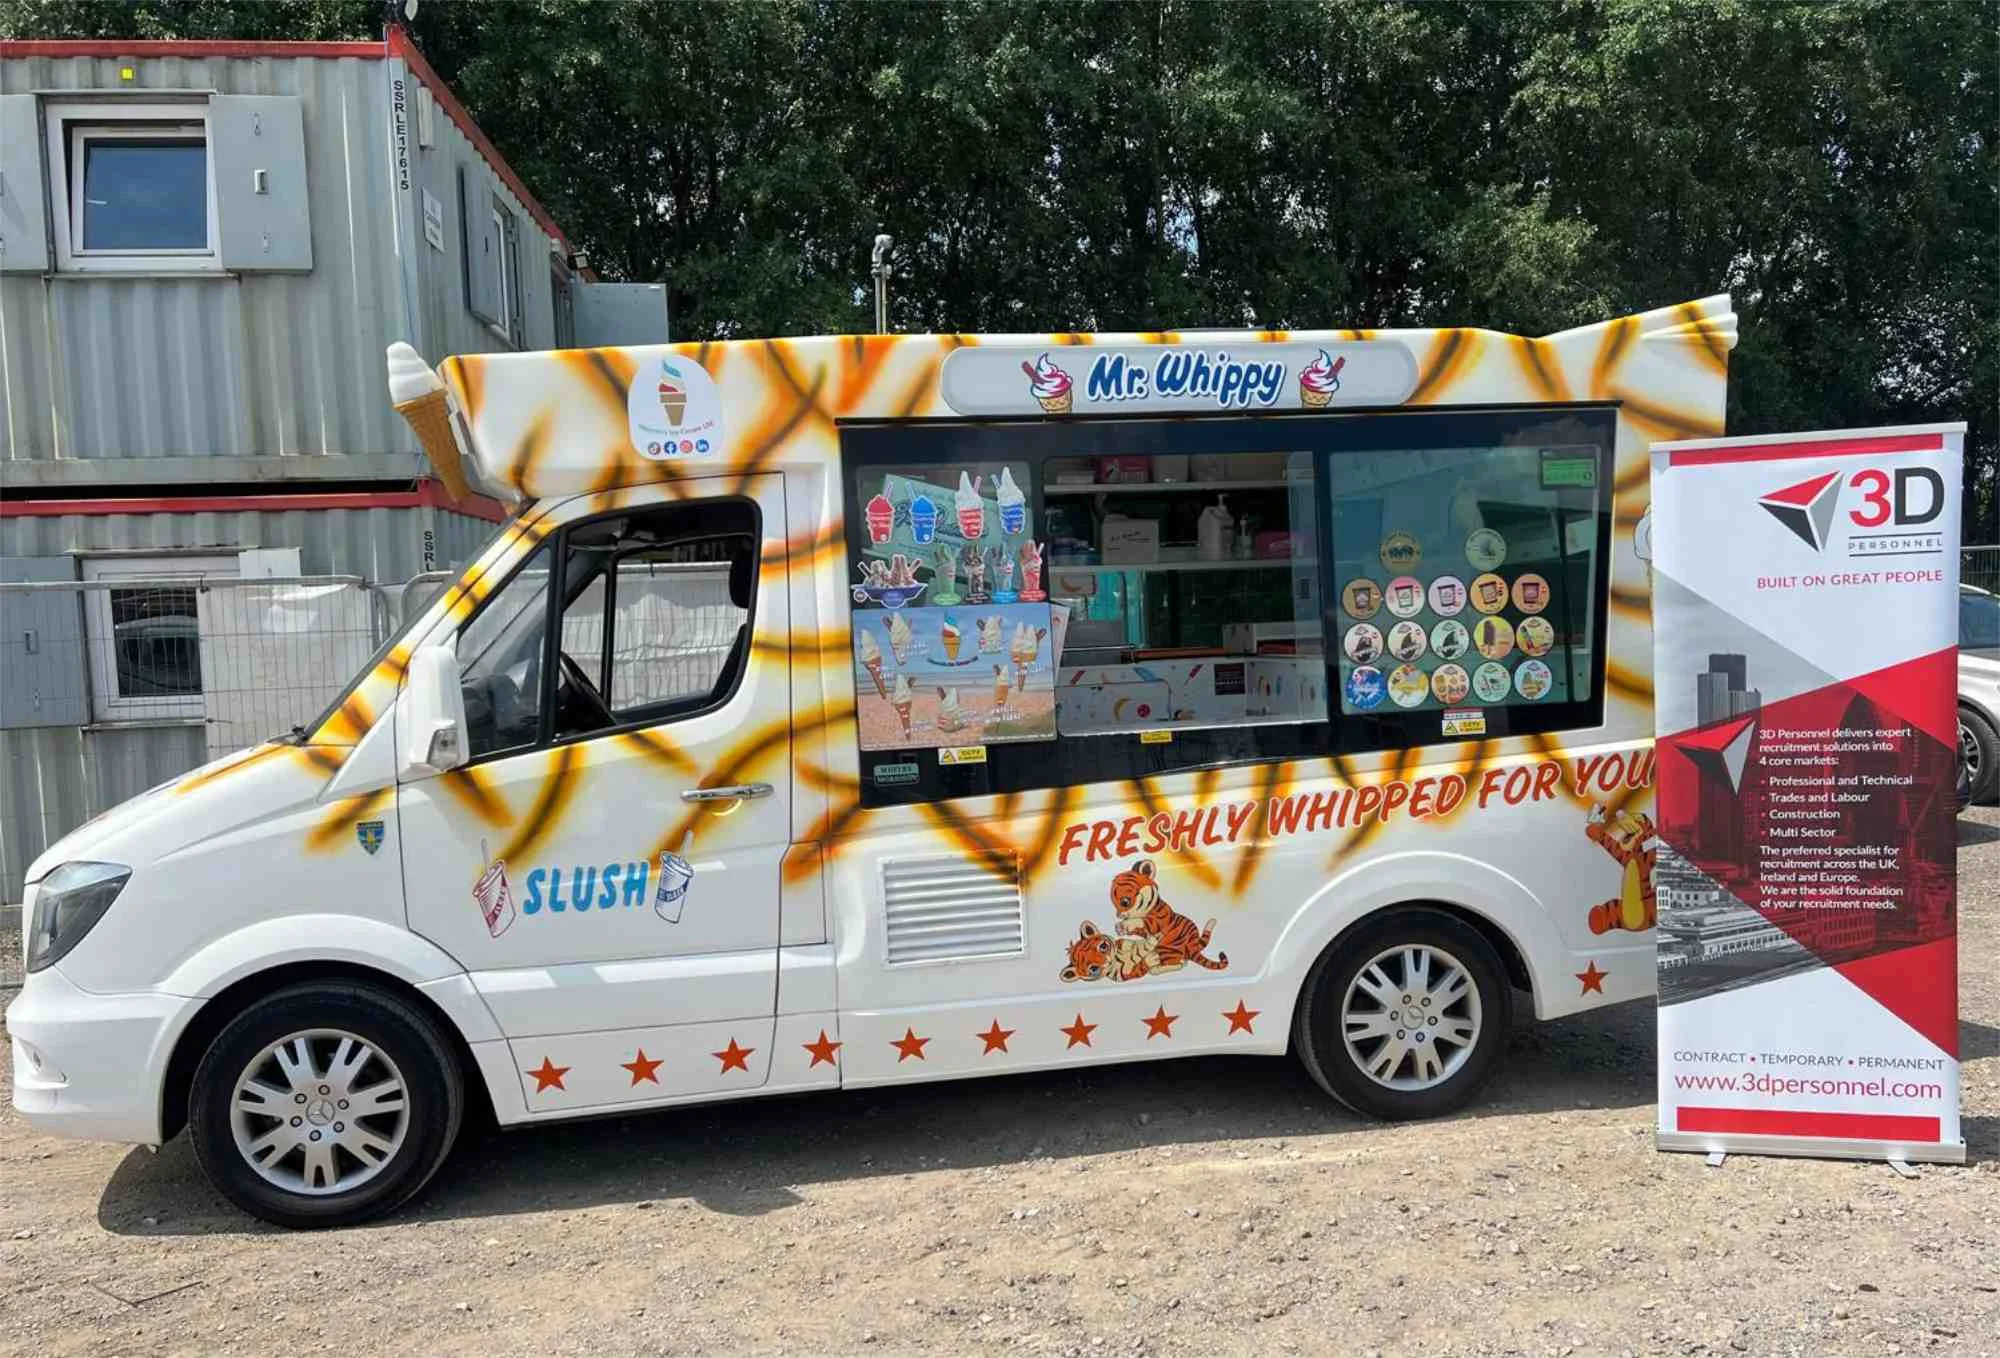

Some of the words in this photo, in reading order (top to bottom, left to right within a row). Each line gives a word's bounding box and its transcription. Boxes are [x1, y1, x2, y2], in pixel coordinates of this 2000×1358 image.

[393, 80, 409, 190] SSRLE17615
[1087, 353, 1148, 400] Mr.
[1155, 350, 1286, 407] Whippy
[1850, 467, 1945, 528] 3D
[1849, 538, 1942, 551] PERSONNEL
[1758, 576, 1797, 589] BUILT
[1803, 575, 1826, 586] ON
[1831, 573, 1881, 586] GREAT
[1886, 569, 1943, 583] PEOPLE
[1760, 729, 1775, 739] 3D
[1778, 728, 1830, 739] Personnel
[1832, 728, 1873, 738] delivers
[1875, 728, 1911, 740] expert
[1760, 741, 1820, 752] recruitment
[1823, 741, 1870, 751] solutions
[1872, 741, 1894, 751] into
[1760, 756, 1767, 766] 4
[1769, 757, 1792, 765] core
[1794, 756, 1839, 765] markets:
[1769, 776, 1835, 786] Professional
[1838, 776, 1858, 785] and
[1862, 775, 1913, 785] Technical
[1769, 792, 1805, 802] Trades
[1808, 792, 1828, 802] and
[1831, 791, 1871, 801] Labour
[1059, 802, 1255, 865] FRESHLY
[1269, 775, 1465, 835] WHIPPED
[1478, 761, 1561, 809] FOR
[1769, 808, 1841, 819] Construction
[1769, 827, 1798, 837] Multi
[1800, 827, 1837, 837] Sector
[1760, 846, 1779, 855] The
[1782, 845, 1831, 857] preferred
[1833, 845, 1881, 857] specialist
[1883, 845, 1900, 854] for
[1760, 859, 1820, 869] recruitment
[1823, 860, 1857, 869] across
[1859, 859, 1877, 868] the
[1760, 872, 1796, 881] Ireland
[1798, 872, 1818, 881] and
[1820, 872, 1860, 883] Europe.
[523, 862, 649, 916] SLUSH
[1760, 886, 1779, 895] We
[1780, 887, 1798, 895] are
[1800, 886, 1817, 895] the
[1819, 885, 1843, 895] solid
[1845, 885, 1903, 896] foundation
[1760, 899, 1771, 907] of
[1773, 901, 1797, 910] your
[1799, 899, 1860, 909] recruitment
[1863, 900, 1897, 909] needs.
[1674, 1051, 1745, 1063] CONTRACT
[1760, 1053, 1843, 1066] TEMPORARY
[1859, 1056, 1944, 1070] PERMANENT
[1675, 1072, 1942, 1098] www.3dpersonnel.com
